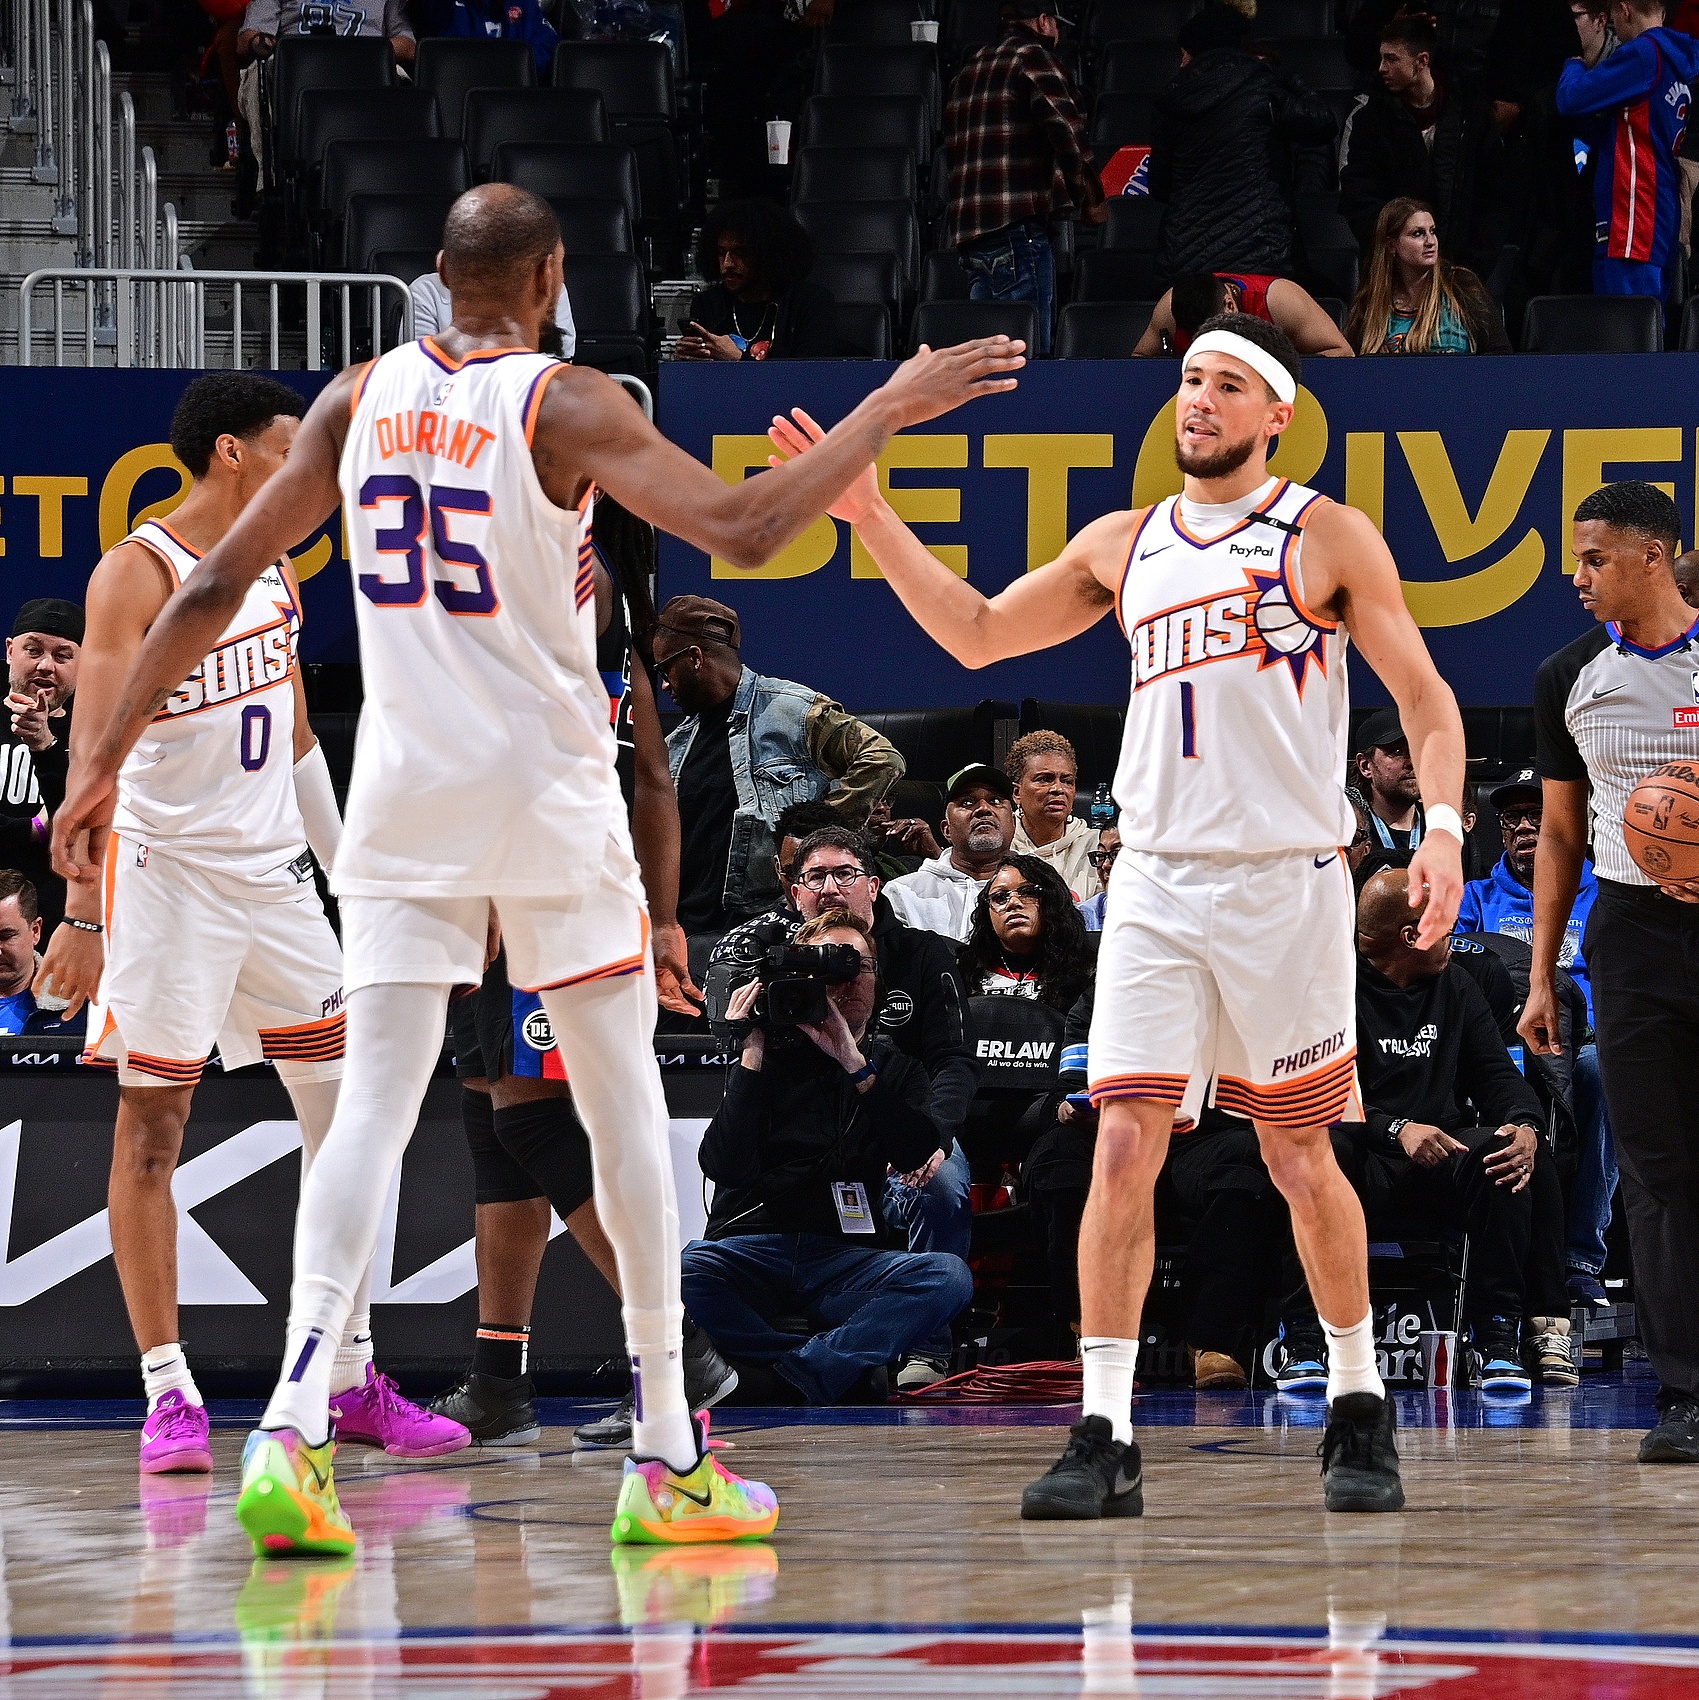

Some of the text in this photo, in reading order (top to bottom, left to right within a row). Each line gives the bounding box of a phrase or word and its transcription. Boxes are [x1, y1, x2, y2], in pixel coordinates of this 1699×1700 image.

[375, 409, 497, 470] DURANT
[359, 474, 502, 618] 35
[1229, 544, 1274, 558] PayPal
[1131, 594, 1248, 690] UNS
[240, 704, 273, 773] 0
[1179, 681, 1200, 759] 1
[11, 1053, 60, 1065] KIA
[1012, 1060, 1025, 1068] do
[1025, 1060, 1033, 1068] is
[1271, 1027, 1347, 1077] PHOENIX
